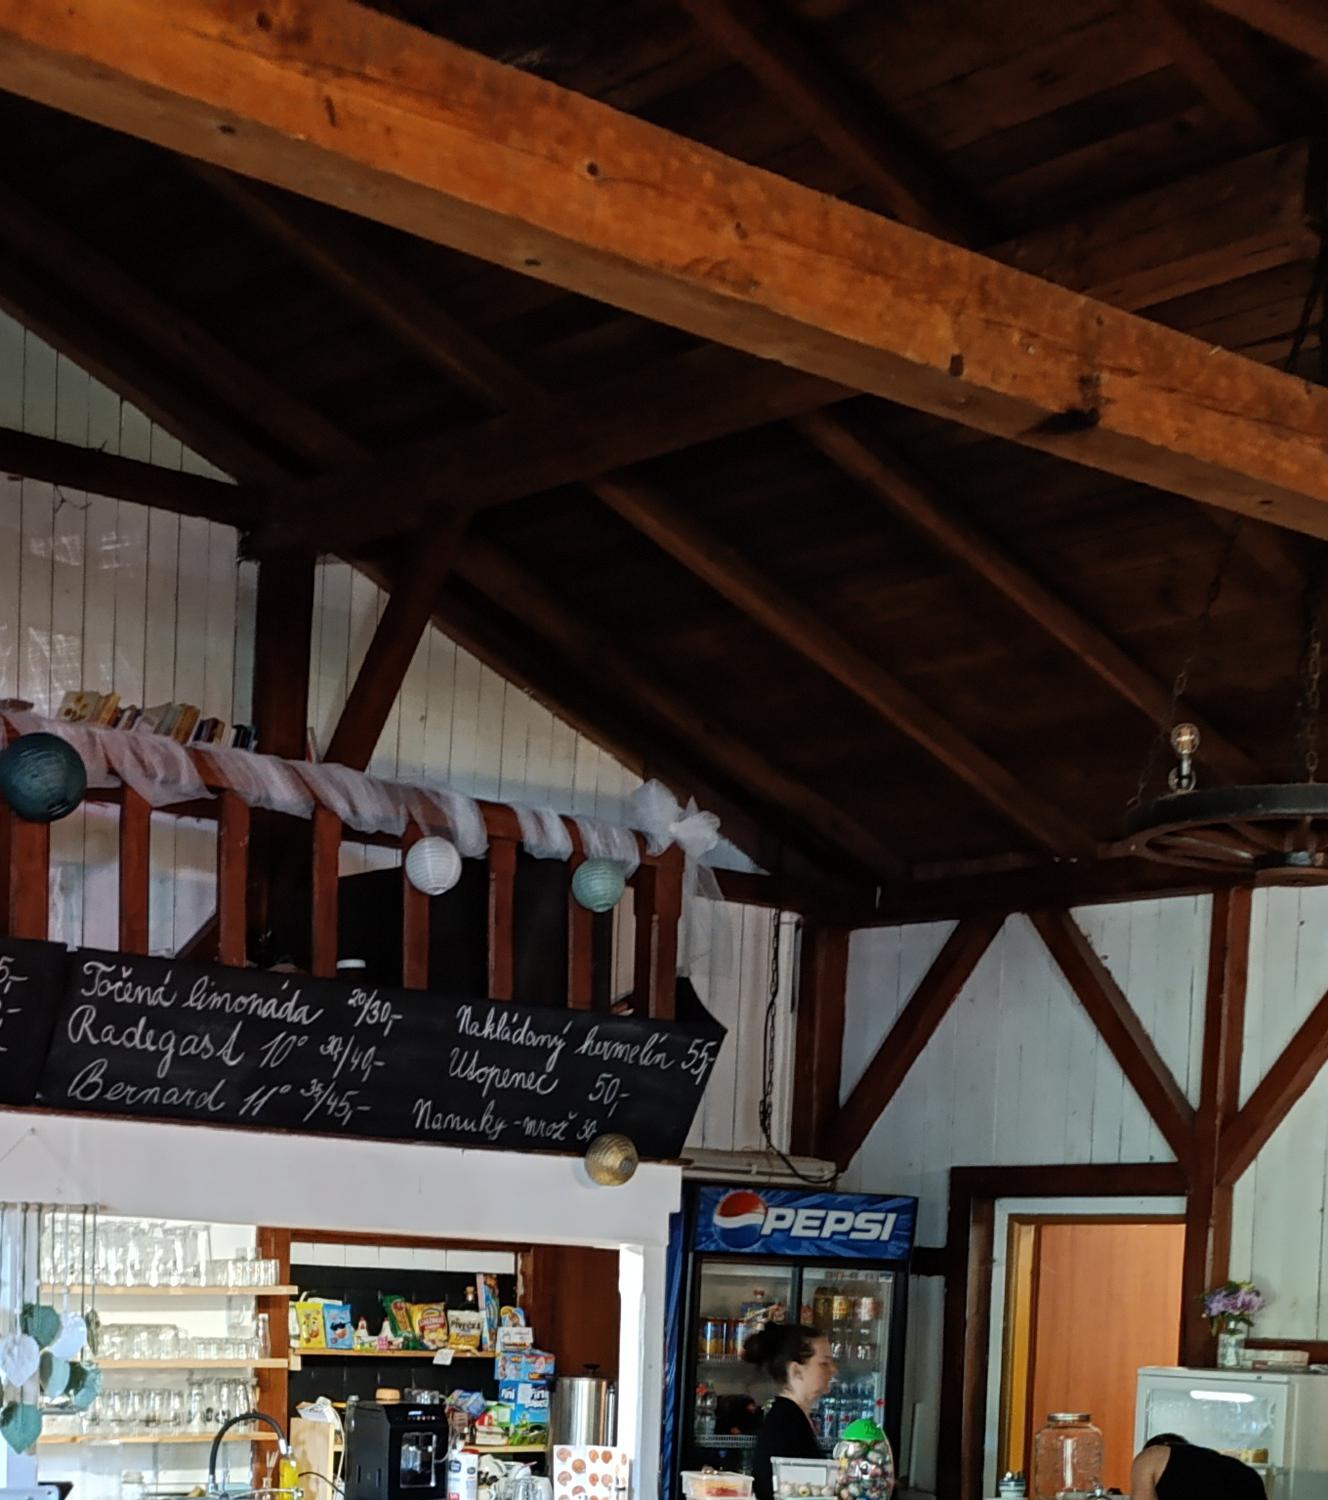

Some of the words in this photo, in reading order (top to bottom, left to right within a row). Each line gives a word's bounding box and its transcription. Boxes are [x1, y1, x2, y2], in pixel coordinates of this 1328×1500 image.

[80, 961, 177, 1008] Točená
[181, 975, 325, 1026] limonáda
[68, 1004, 245, 1079] Radegast
[456, 1004, 573, 1071] Nakládaný
[575, 1025, 676, 1069] hermelín
[68, 1058, 226, 1113] Bernard
[412, 1098, 508, 1141] Nanuky
[760, 1206, 898, 1241] PEPSI
